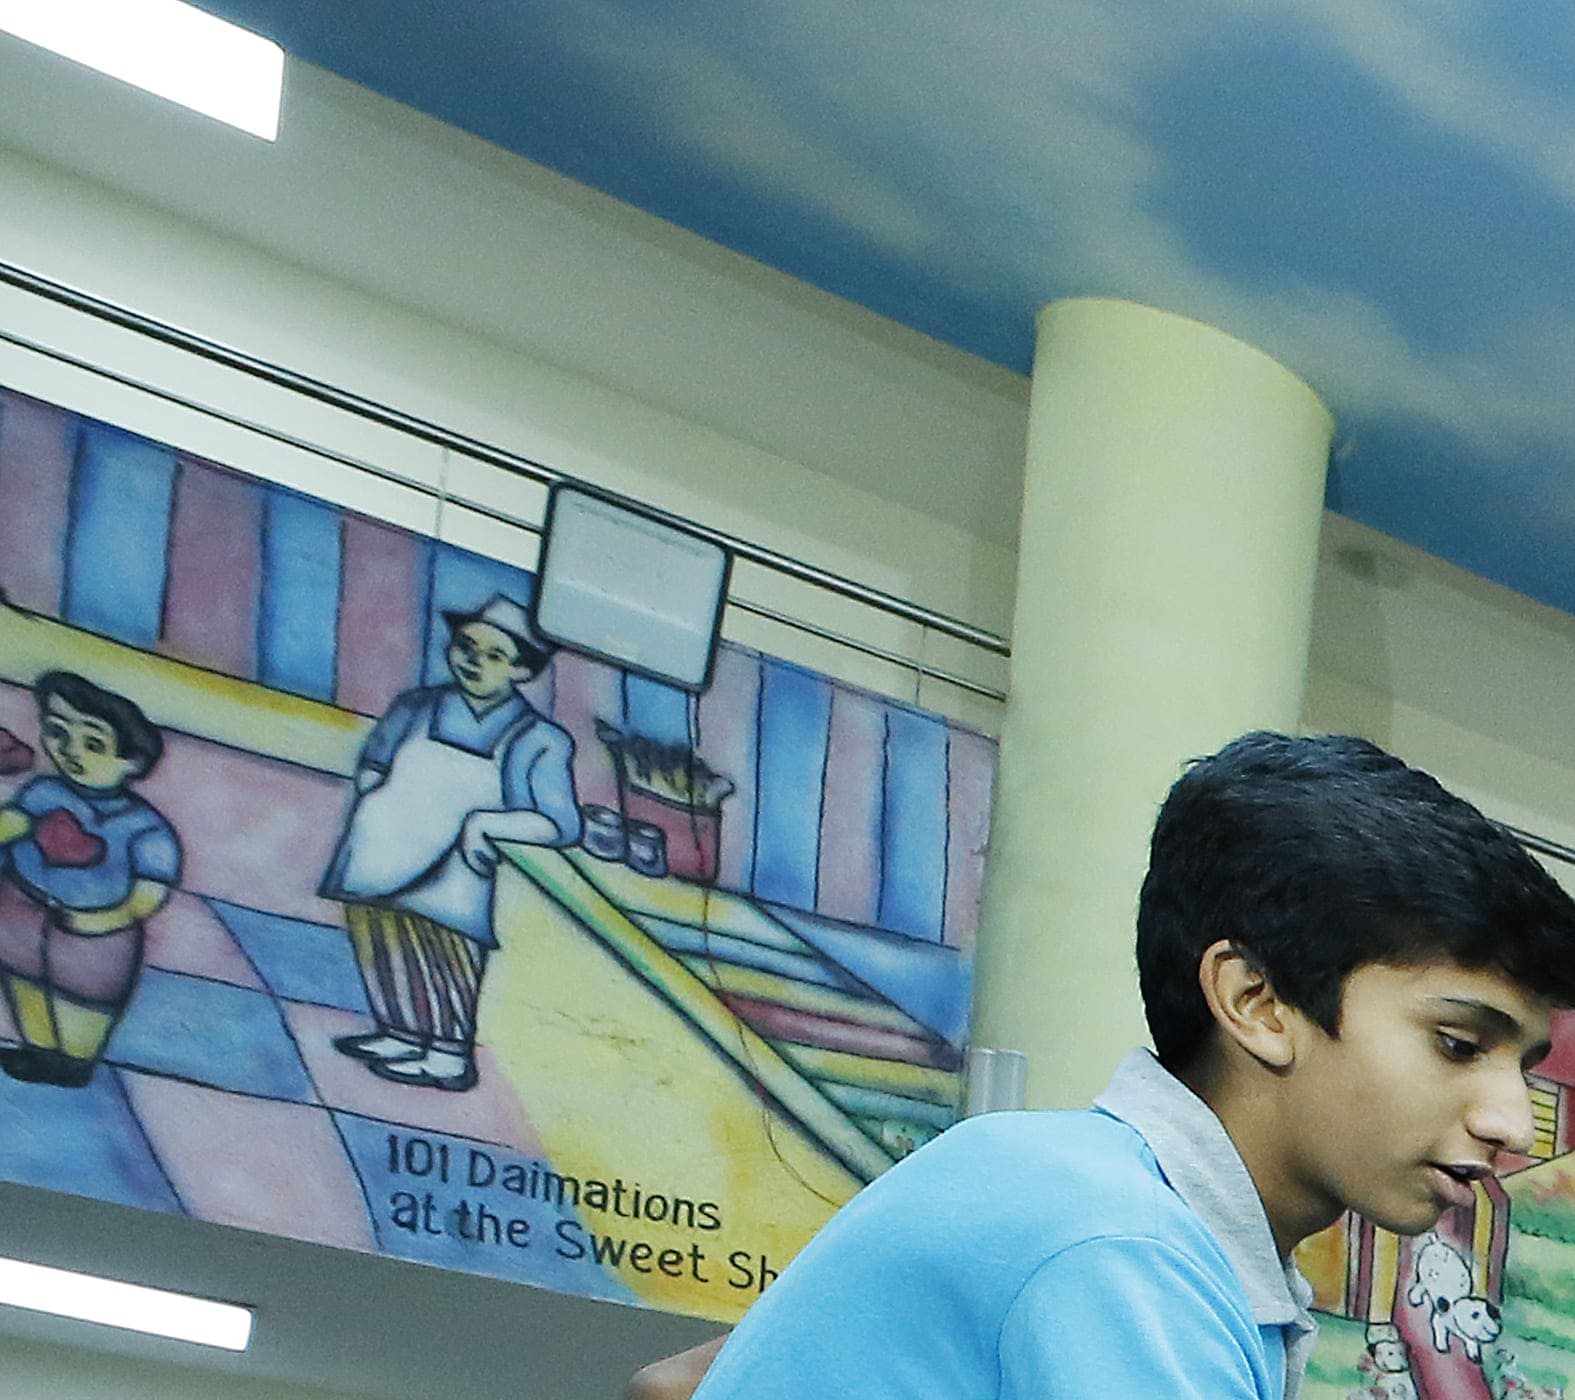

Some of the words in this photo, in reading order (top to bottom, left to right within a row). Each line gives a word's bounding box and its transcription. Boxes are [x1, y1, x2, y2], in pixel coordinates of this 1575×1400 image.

[387, 1134, 450, 1183] 101
[391, 1191, 442, 1236] at
[449, 1199, 531, 1248] the
[555, 1220, 711, 1283] Sweet
[728, 1250, 780, 1293] Sh
